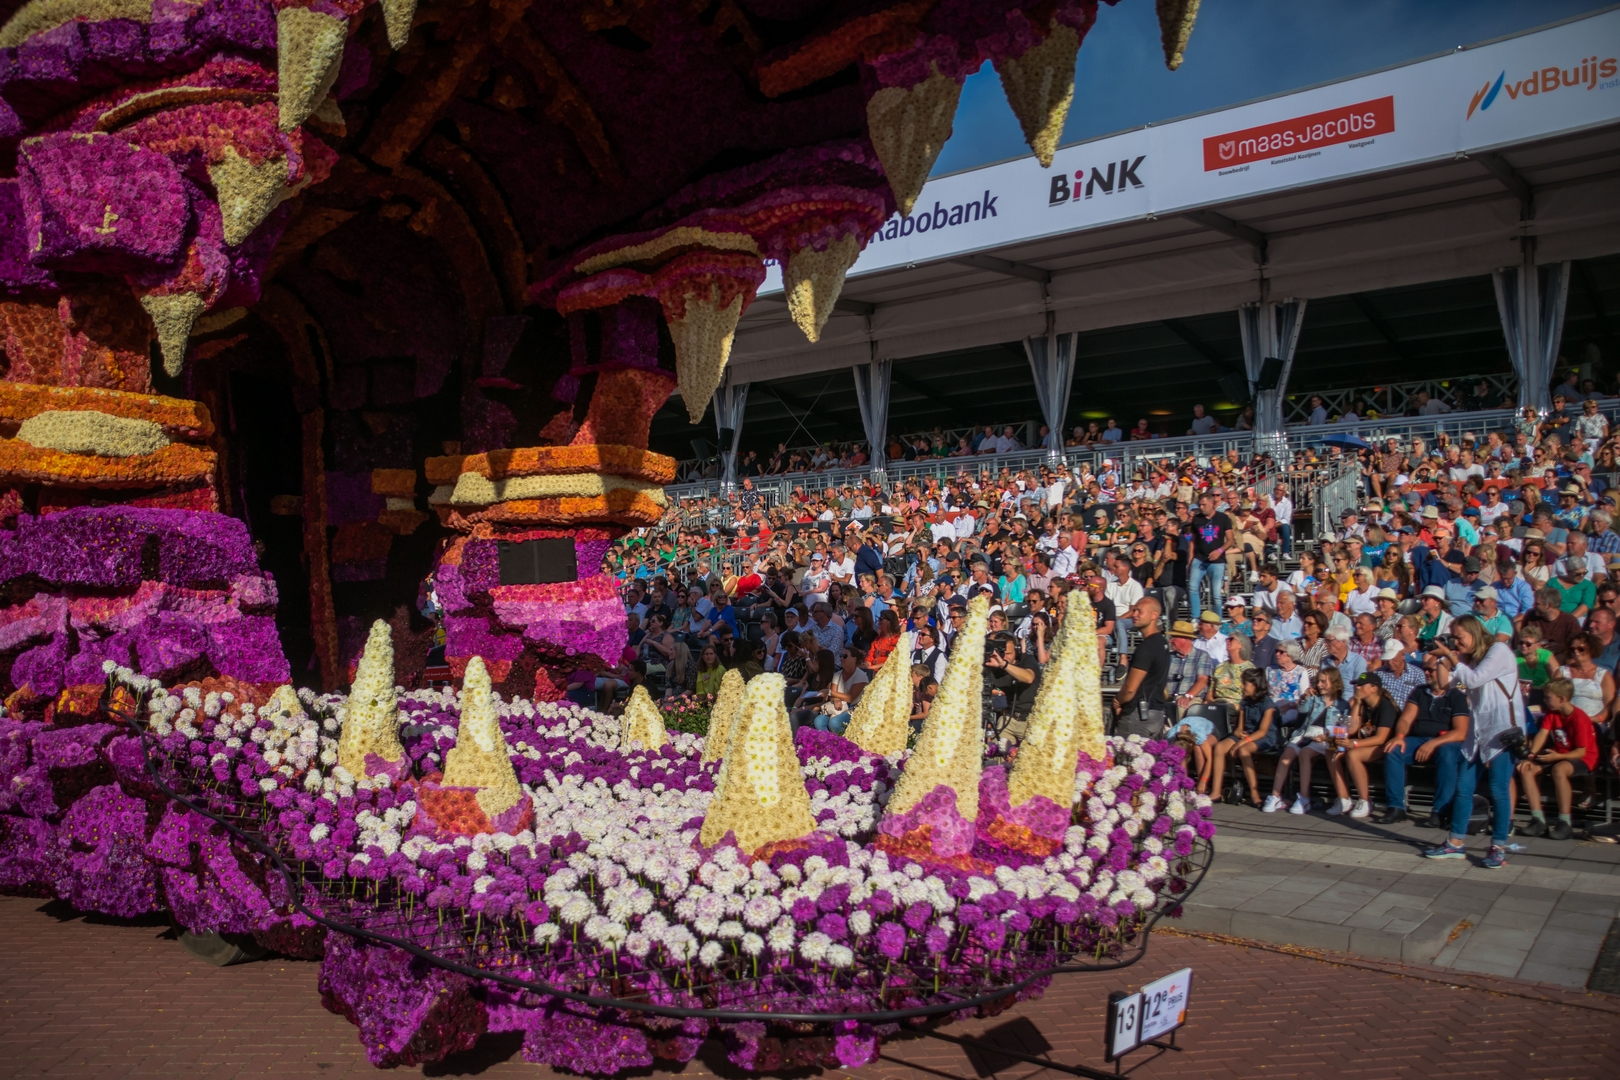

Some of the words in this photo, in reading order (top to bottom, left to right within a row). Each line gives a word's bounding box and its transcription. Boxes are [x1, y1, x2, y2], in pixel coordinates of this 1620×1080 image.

[1504, 56, 1617, 100] vdBuijs
[1599, 79, 1620, 90] inst
[1270, 155, 1297, 165] Kunststof
[1348, 139, 1375, 149] Vastgoed
[1118, 1003, 1135, 1034] 13
